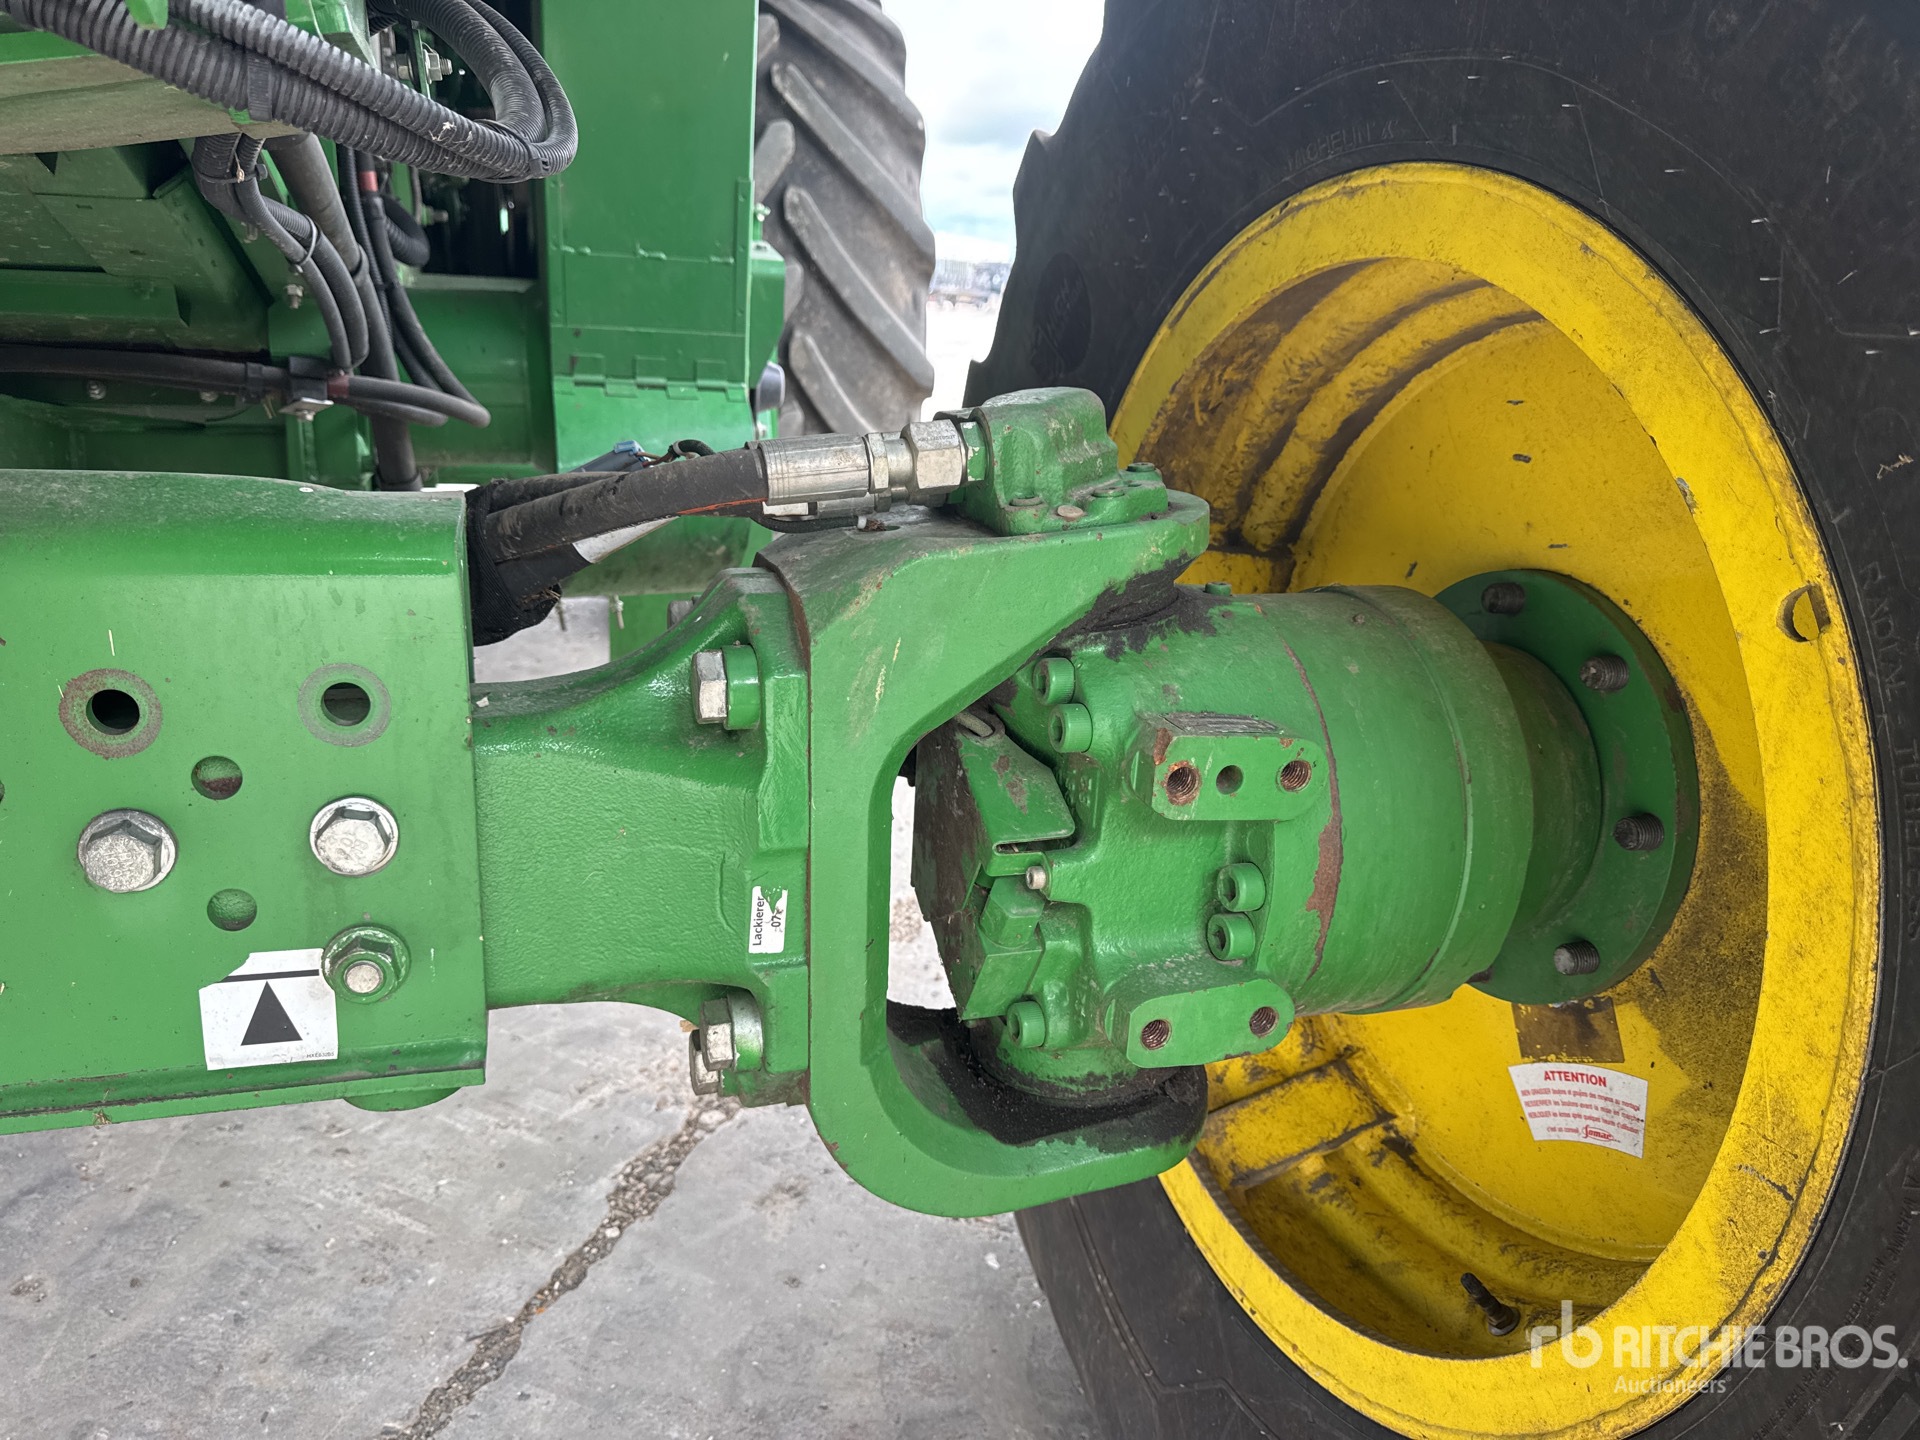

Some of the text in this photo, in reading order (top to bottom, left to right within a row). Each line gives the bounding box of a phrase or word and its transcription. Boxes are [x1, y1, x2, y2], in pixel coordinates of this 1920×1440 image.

[1284, 121, 1371, 171] MICHELIN
[1858, 561, 1906, 701] RADIAL
[752, 896, 764, 946] Lackierer
[1544, 1070, 1607, 1087] ATTENTION
